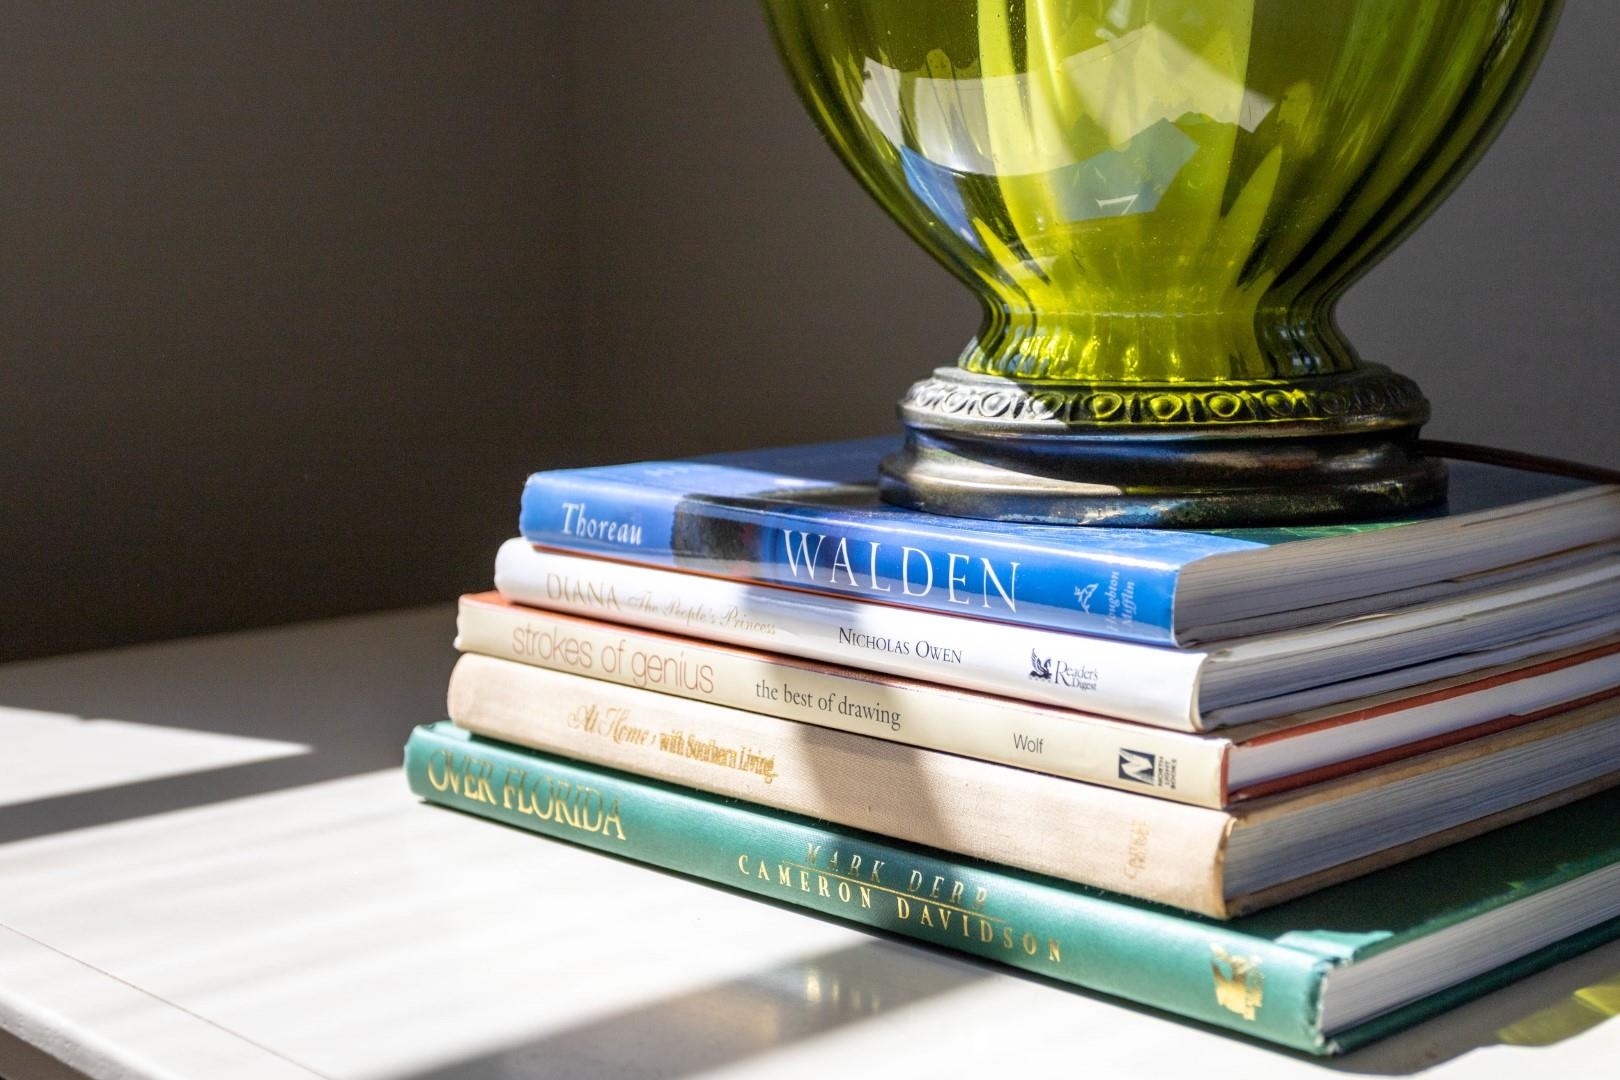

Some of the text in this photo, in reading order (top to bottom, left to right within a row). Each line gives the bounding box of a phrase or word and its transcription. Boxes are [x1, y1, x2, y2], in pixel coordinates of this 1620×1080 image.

[562, 502, 1020, 614] Thoreau WALDEN
[546, 573, 621, 610] DIANA
[664, 598, 716, 627] People's
[719, 606, 777, 635] Princess
[512, 623, 1044, 754] strokes of genius the best of drawing Wolf
[1054, 660, 1099, 687] Reader's
[599, 707, 650, 744] Home
[660, 728, 684, 756] with
[686, 734, 737, 769] Southern
[738, 745, 777, 784] Living
[428, 749, 626, 841] OVER FLORIDA
[803, 843, 886, 883] MARK
[738, 854, 1062, 963] CAMERON DAVIDSON
